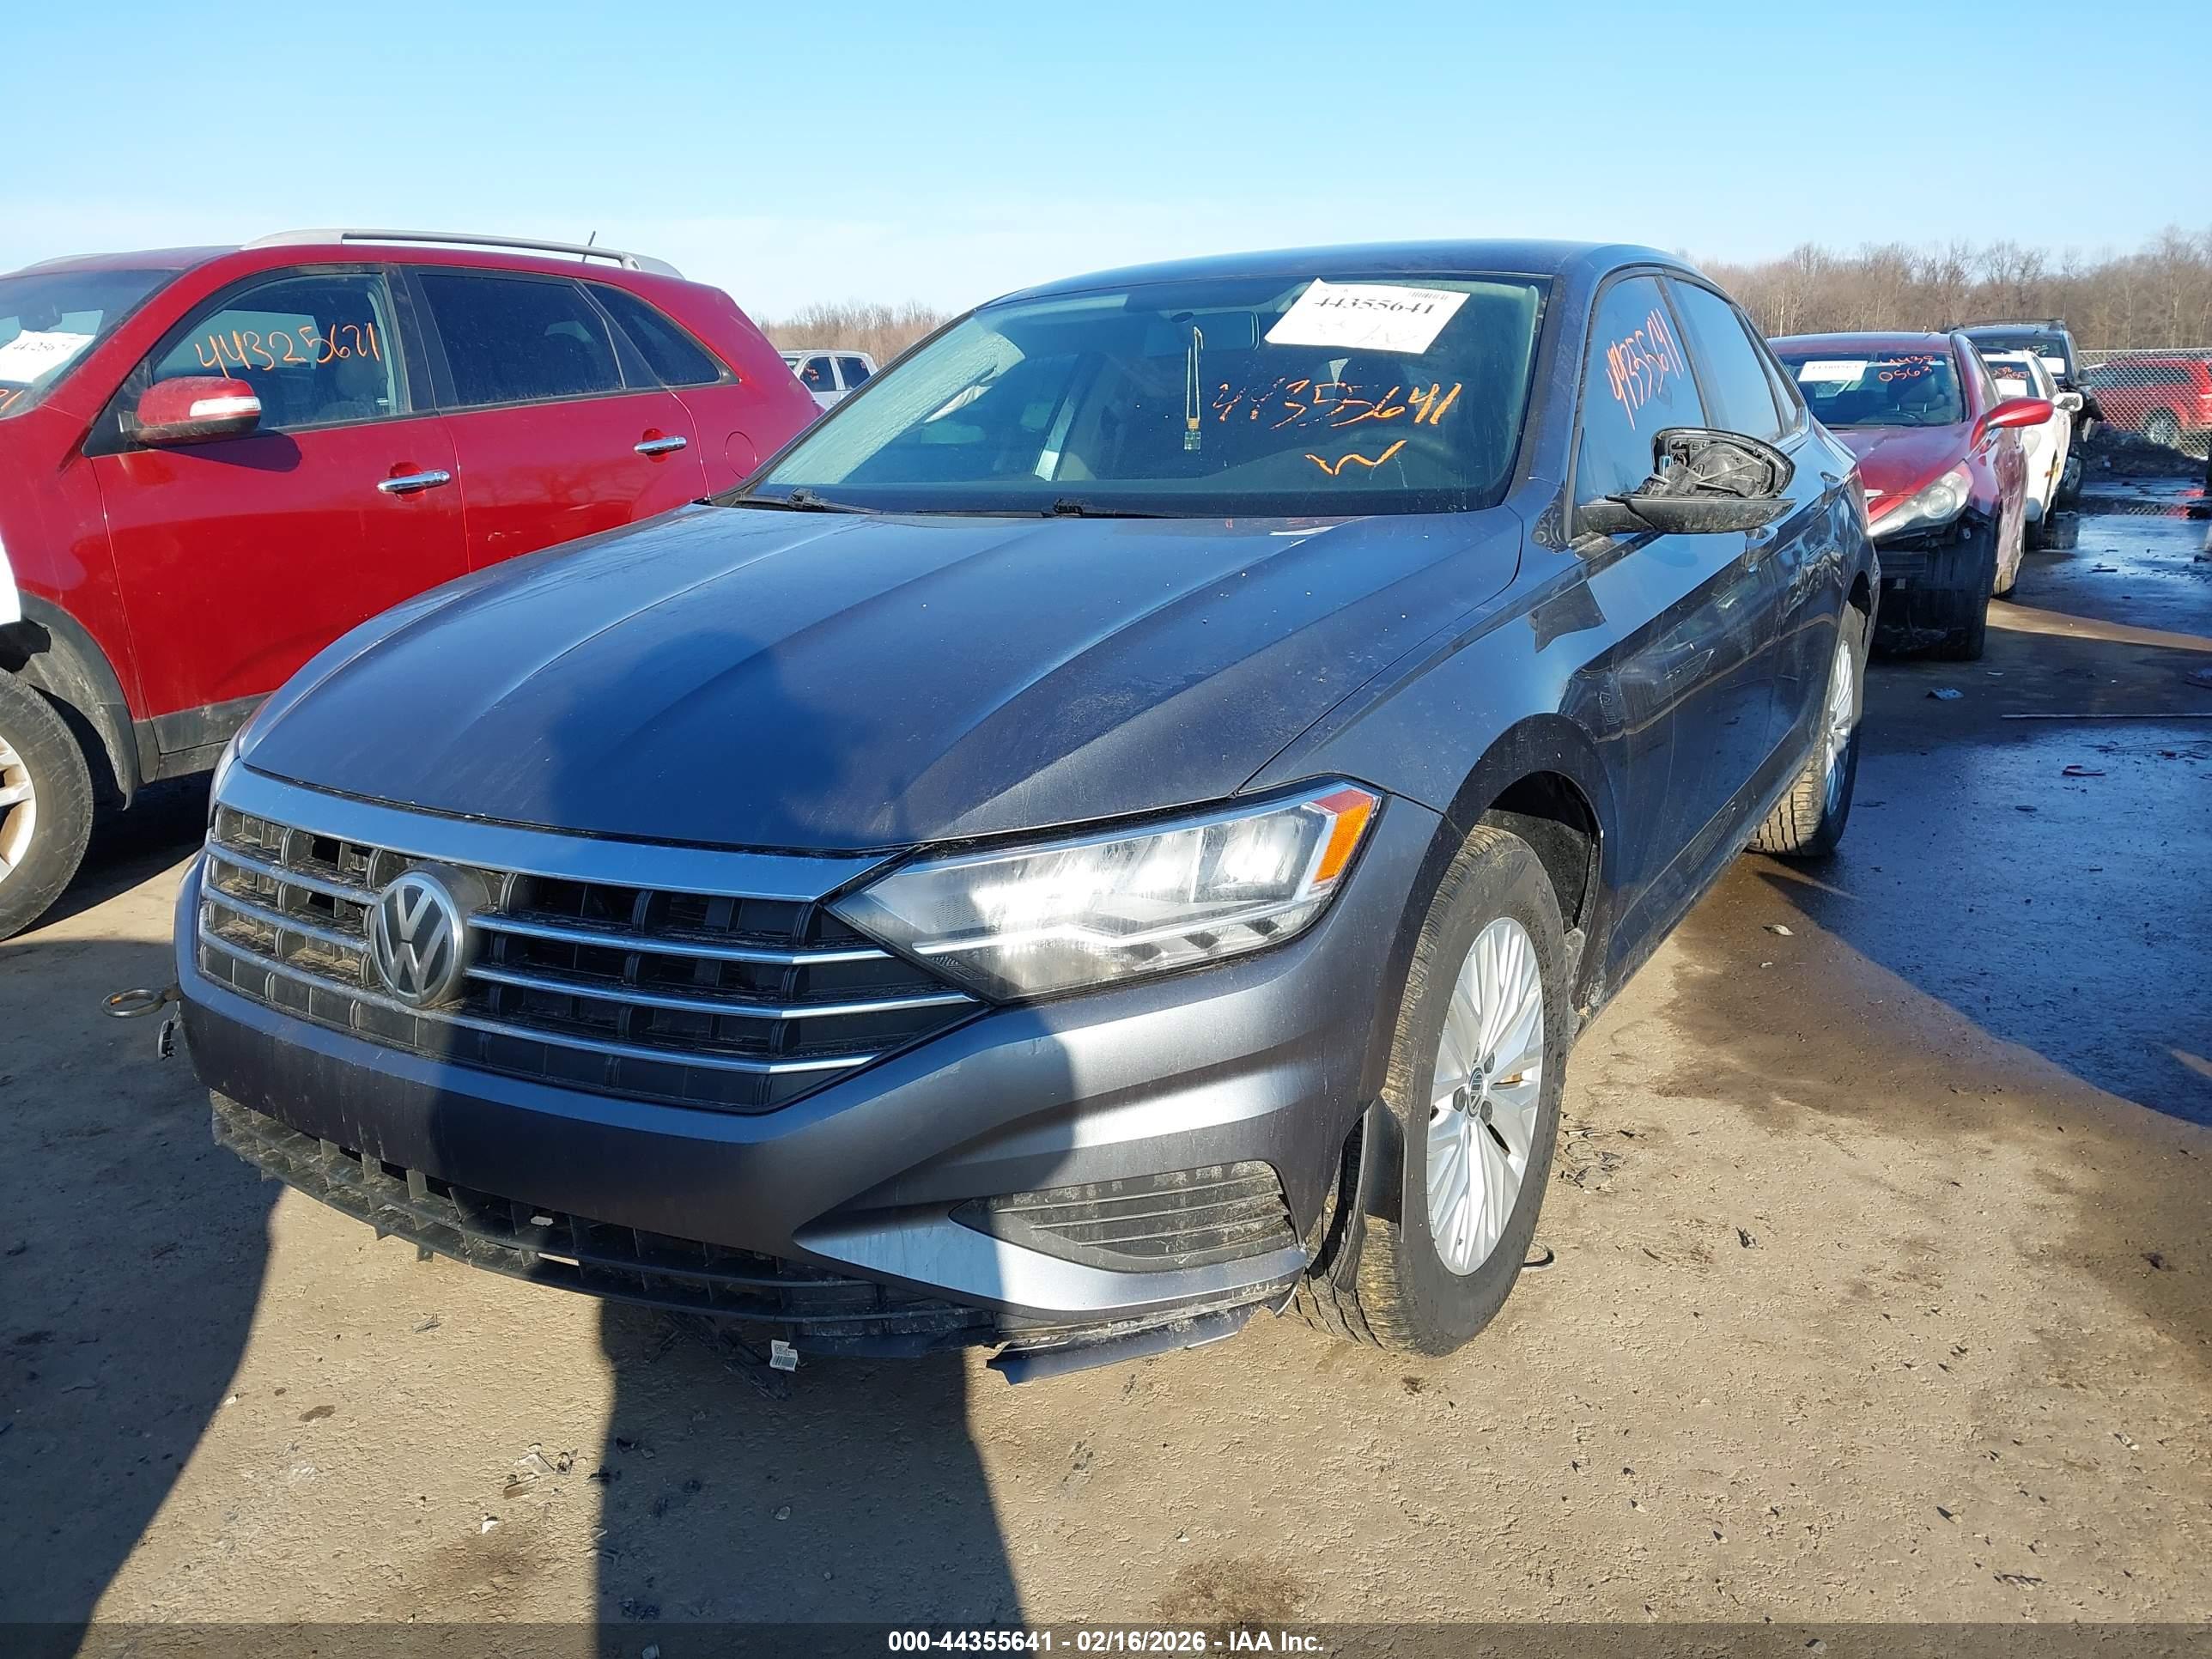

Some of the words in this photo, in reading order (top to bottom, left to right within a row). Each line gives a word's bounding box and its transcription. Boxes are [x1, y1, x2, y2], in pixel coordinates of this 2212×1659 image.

[1314, 296, 1436, 315] 44355641
[1212, 376, 1462, 430] 44355641
[375, 881, 449, 1002] VW
